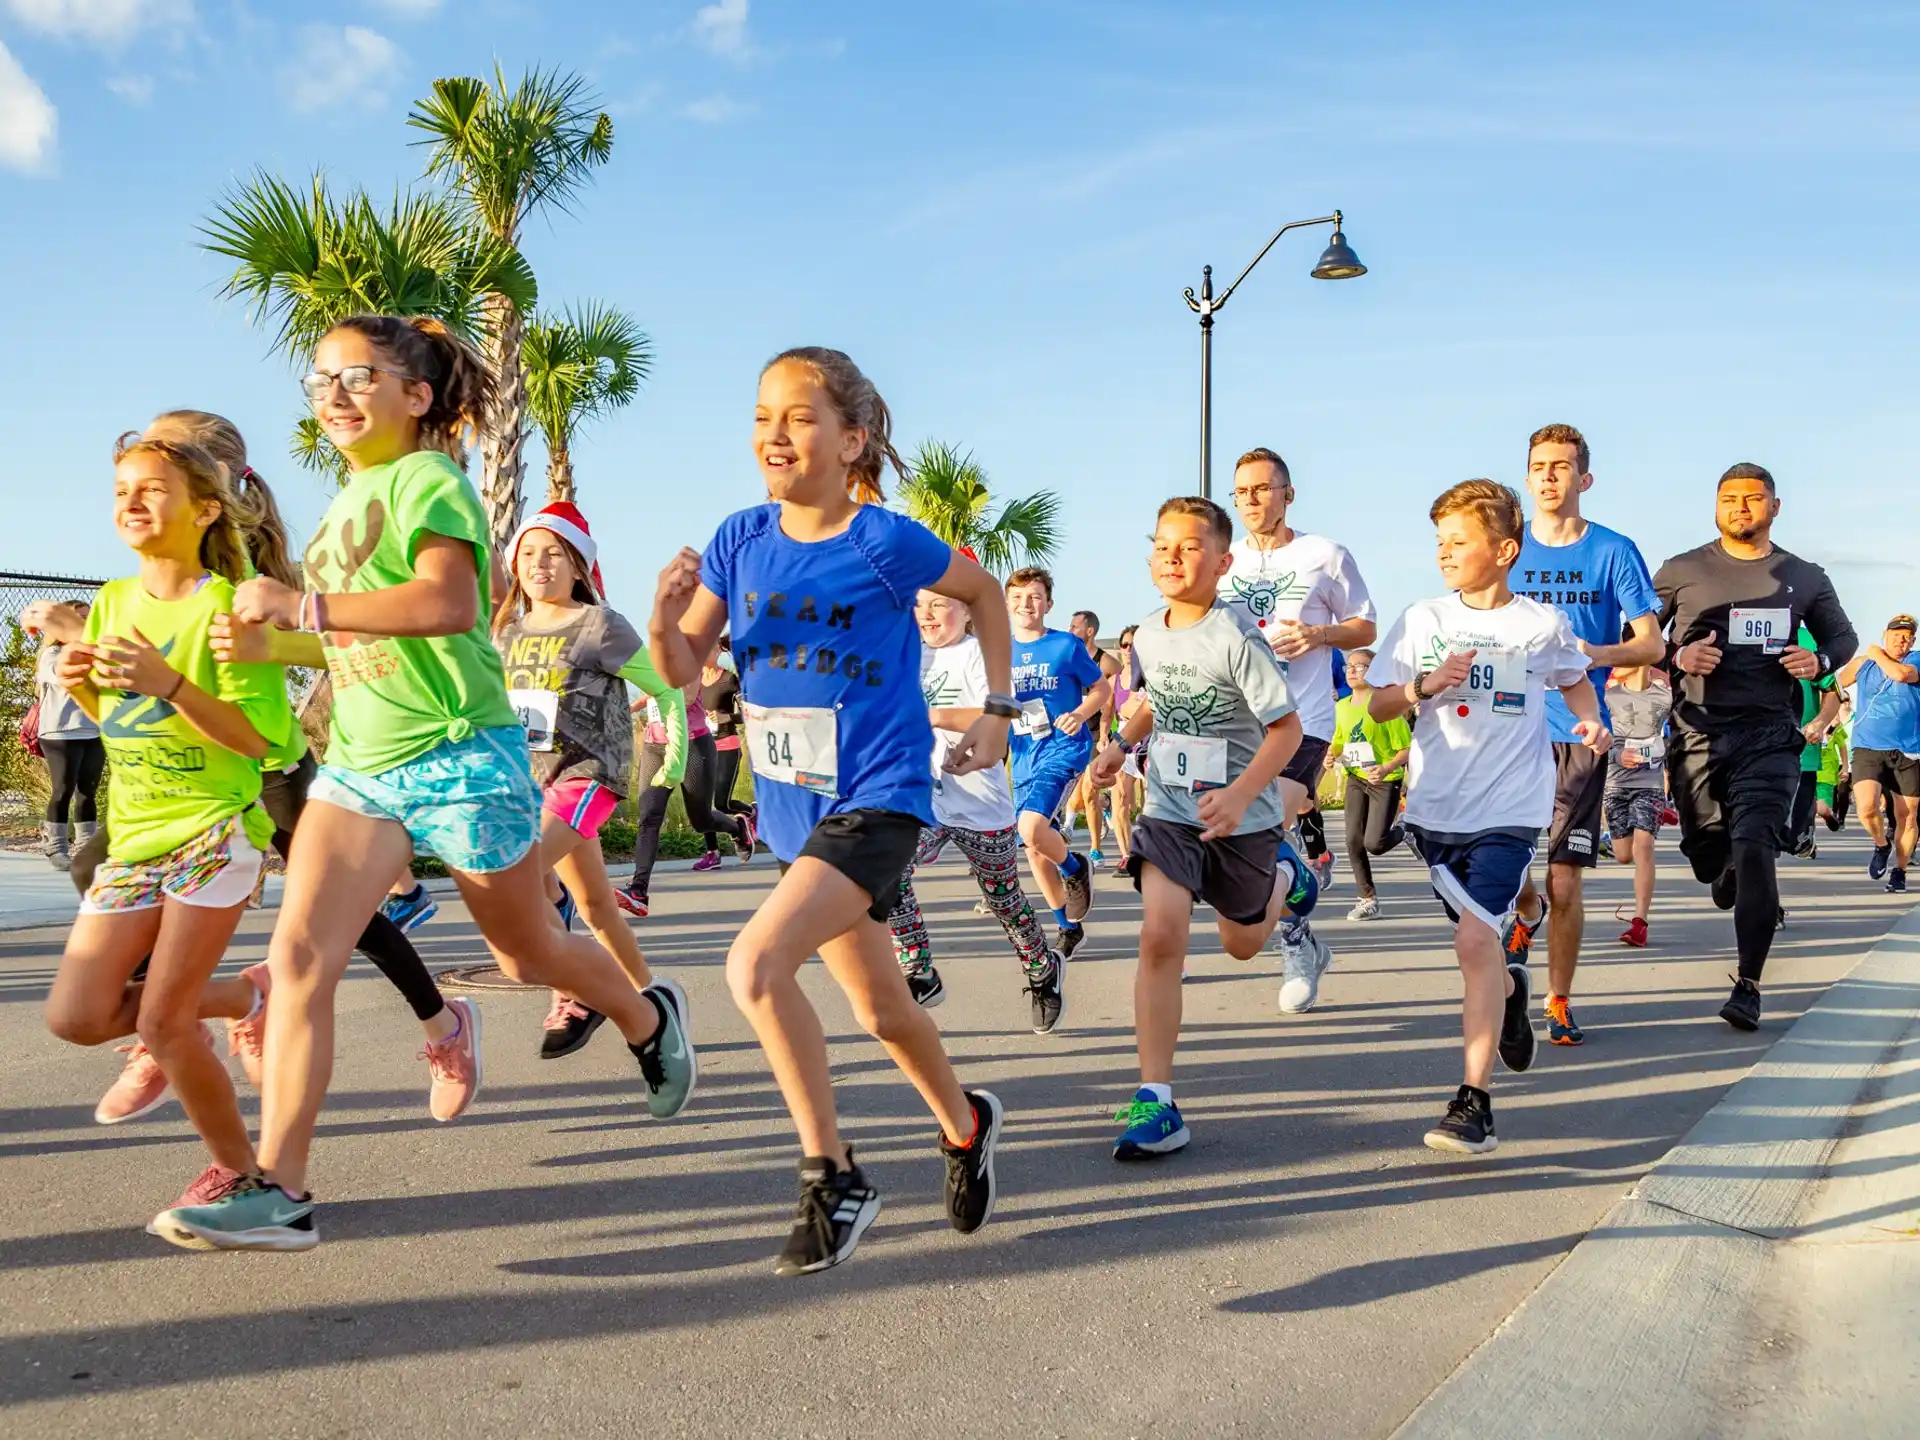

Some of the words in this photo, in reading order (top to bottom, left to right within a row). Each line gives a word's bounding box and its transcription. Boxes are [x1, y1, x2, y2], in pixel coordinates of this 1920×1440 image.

[1524, 570, 1583, 584] TEAM
[1515, 590, 1601, 605] TRIDGE
[744, 592, 856, 630] TEAM
[1468, 632, 1496, 641] Annual
[1745, 620, 1772, 637] 960
[506, 636, 567, 667] NEW
[1039, 662, 1050, 678] IT
[1155, 661, 1179, 679] Jingle
[1180, 663, 1198, 678] Bell
[1470, 664, 1494, 690] 69
[1029, 676, 1059, 692] PLATE
[767, 730, 793, 768] 84
[147, 746, 206, 772] Hall
[1177, 752, 1187, 776] 9
